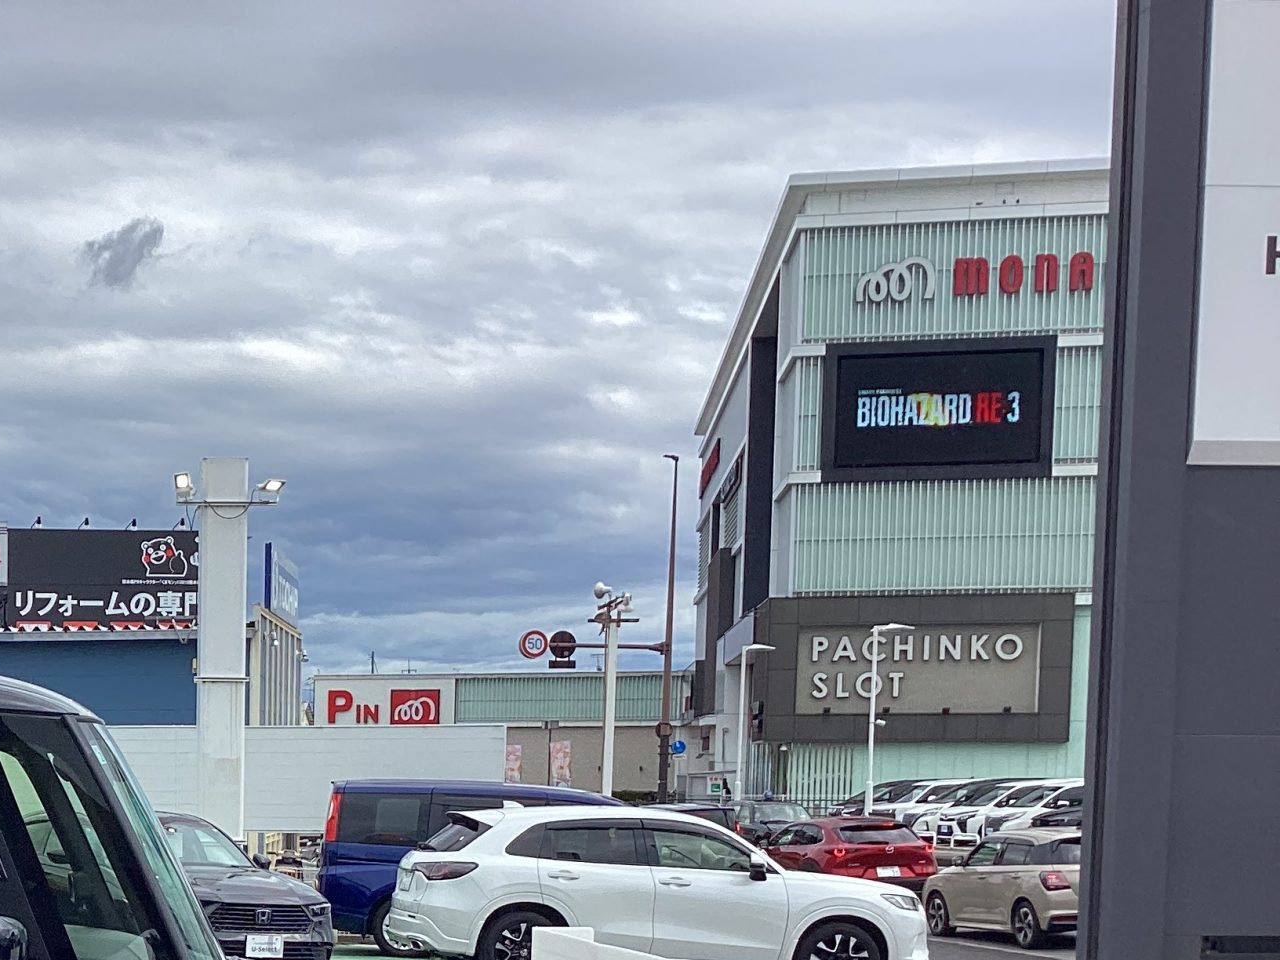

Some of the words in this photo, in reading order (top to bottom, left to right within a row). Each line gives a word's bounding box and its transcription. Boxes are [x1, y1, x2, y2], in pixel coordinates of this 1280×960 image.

[857, 393, 971, 427] BIOHAZARD
[527, 638, 543, 650] 50
[811, 633, 1024, 662] PACHINKO
[811, 671, 904, 699] SLOT
